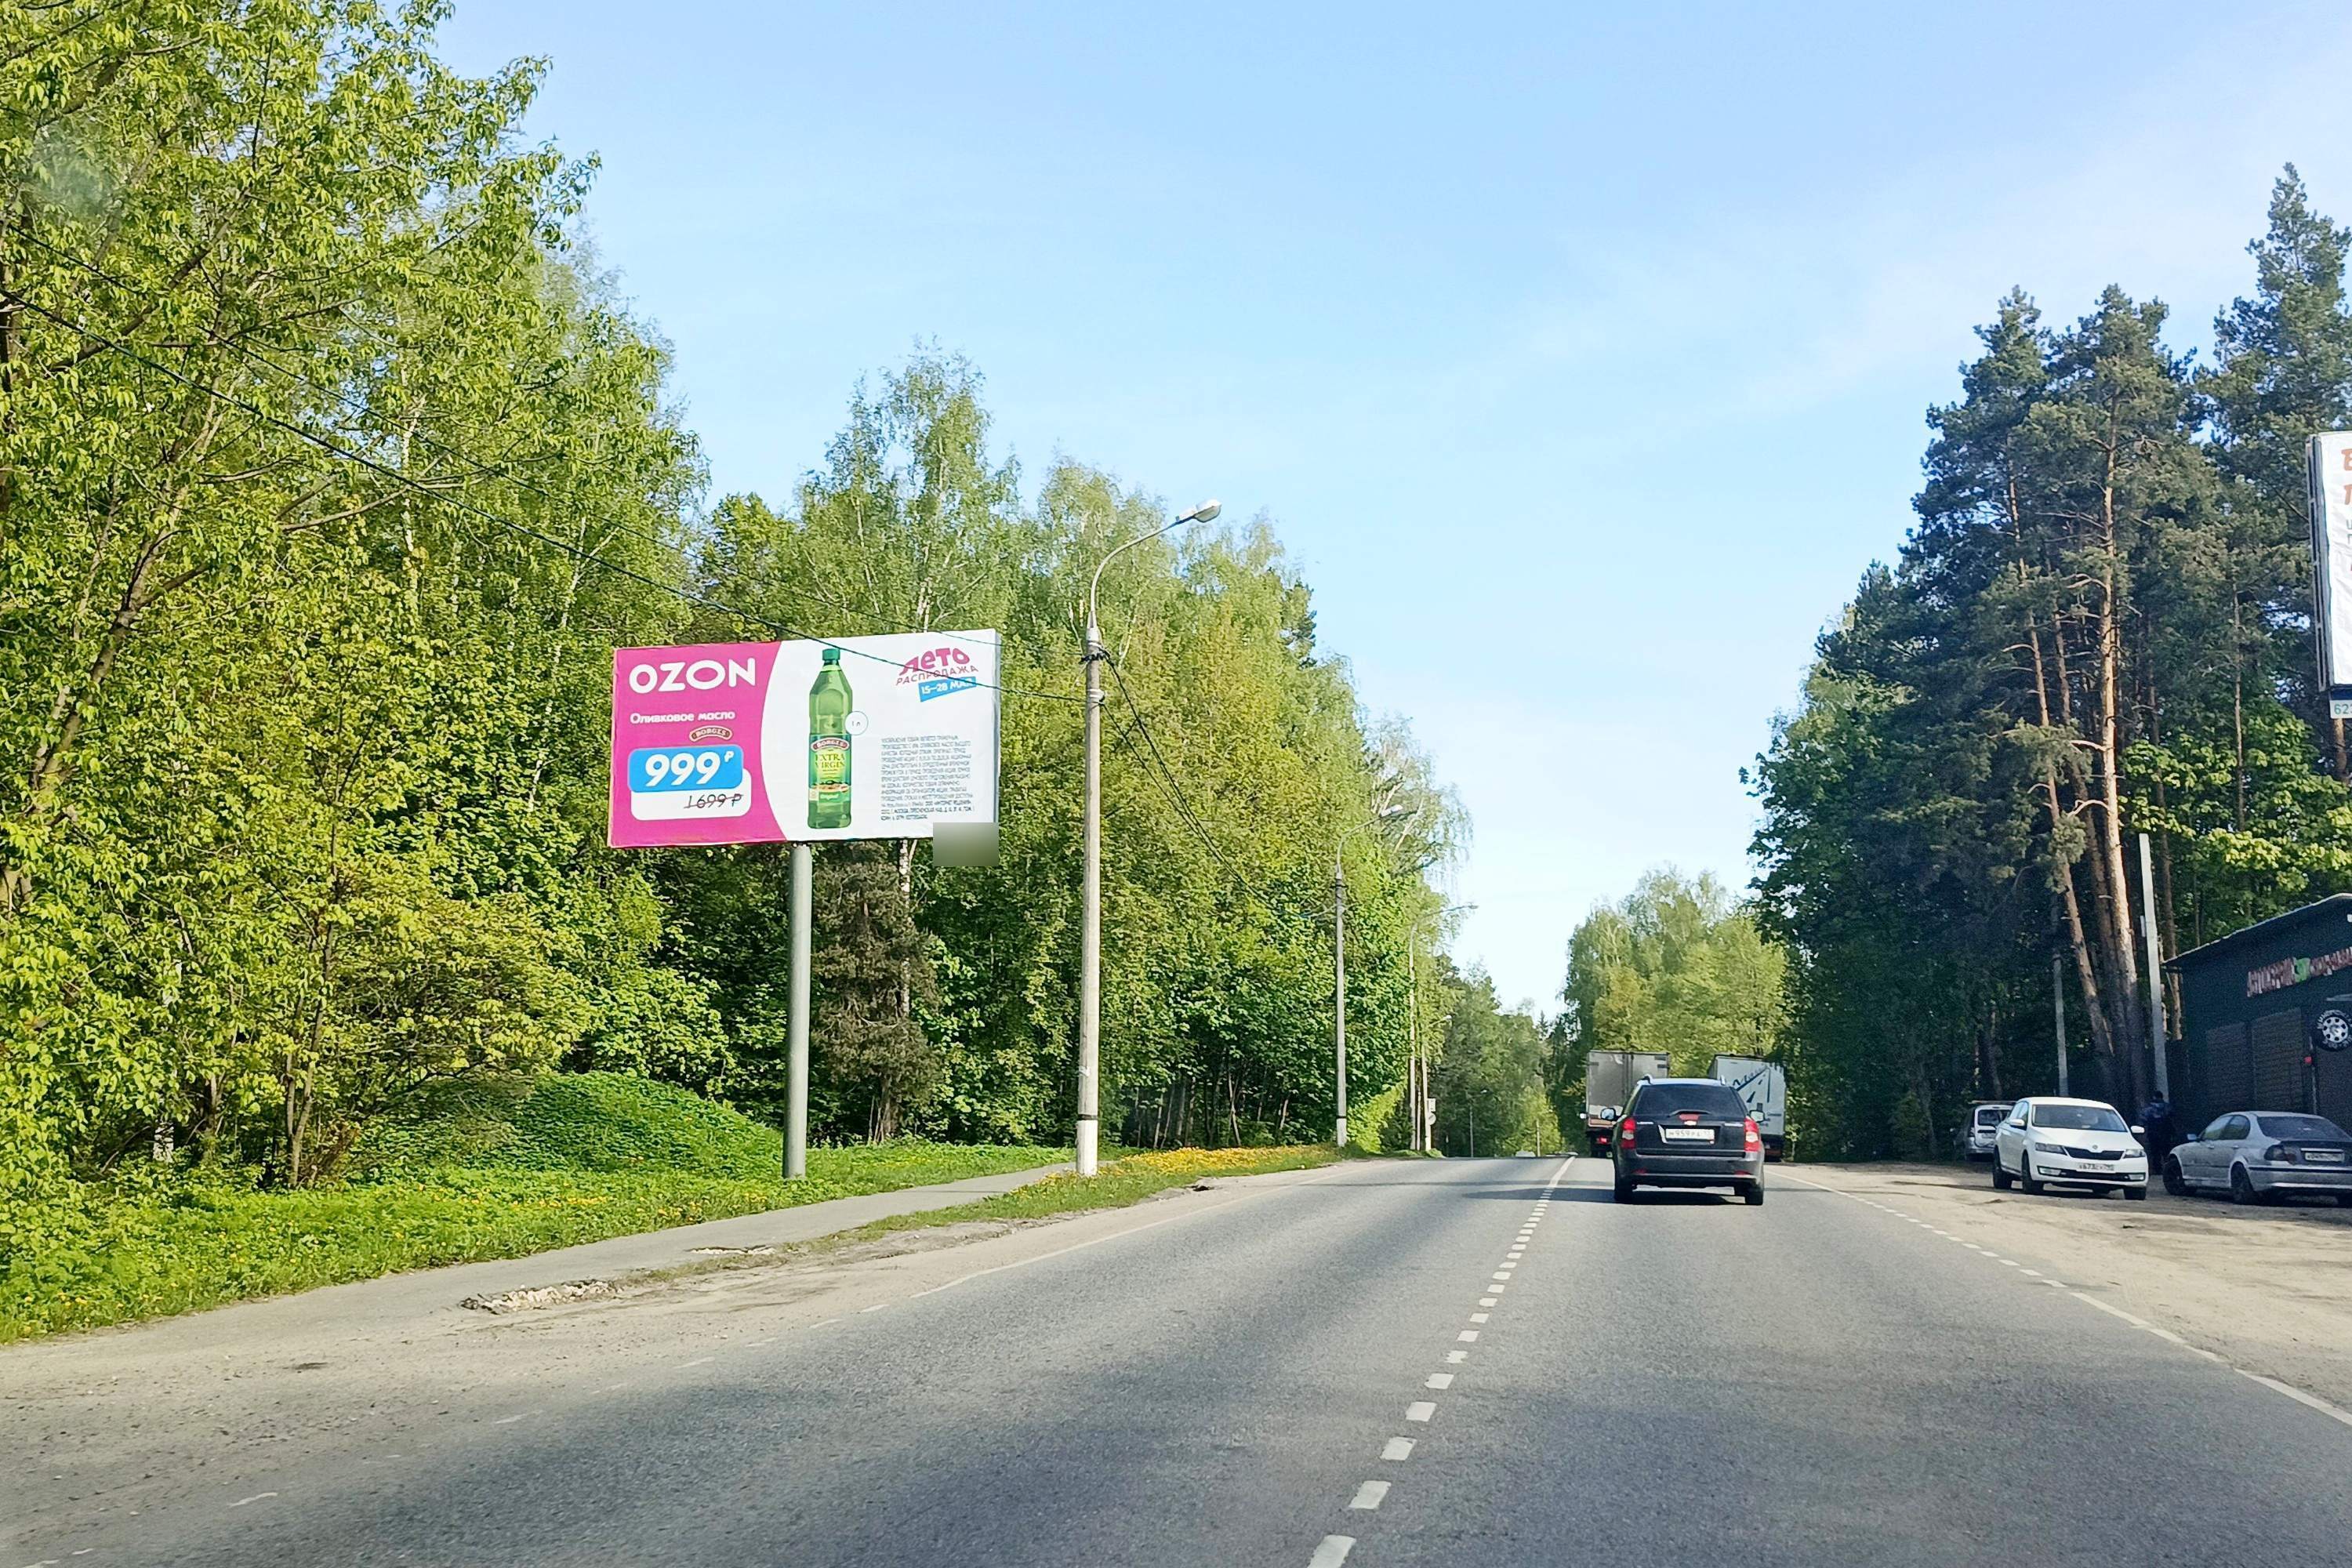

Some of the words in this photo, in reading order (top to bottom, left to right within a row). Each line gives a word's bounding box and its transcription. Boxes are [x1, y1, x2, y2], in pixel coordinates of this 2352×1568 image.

[629, 658, 756, 694] OZON
[2335, 704, 2352, 715] 62
[630, 713, 695, 724] Оливковое
[698, 711, 735, 721] масло
